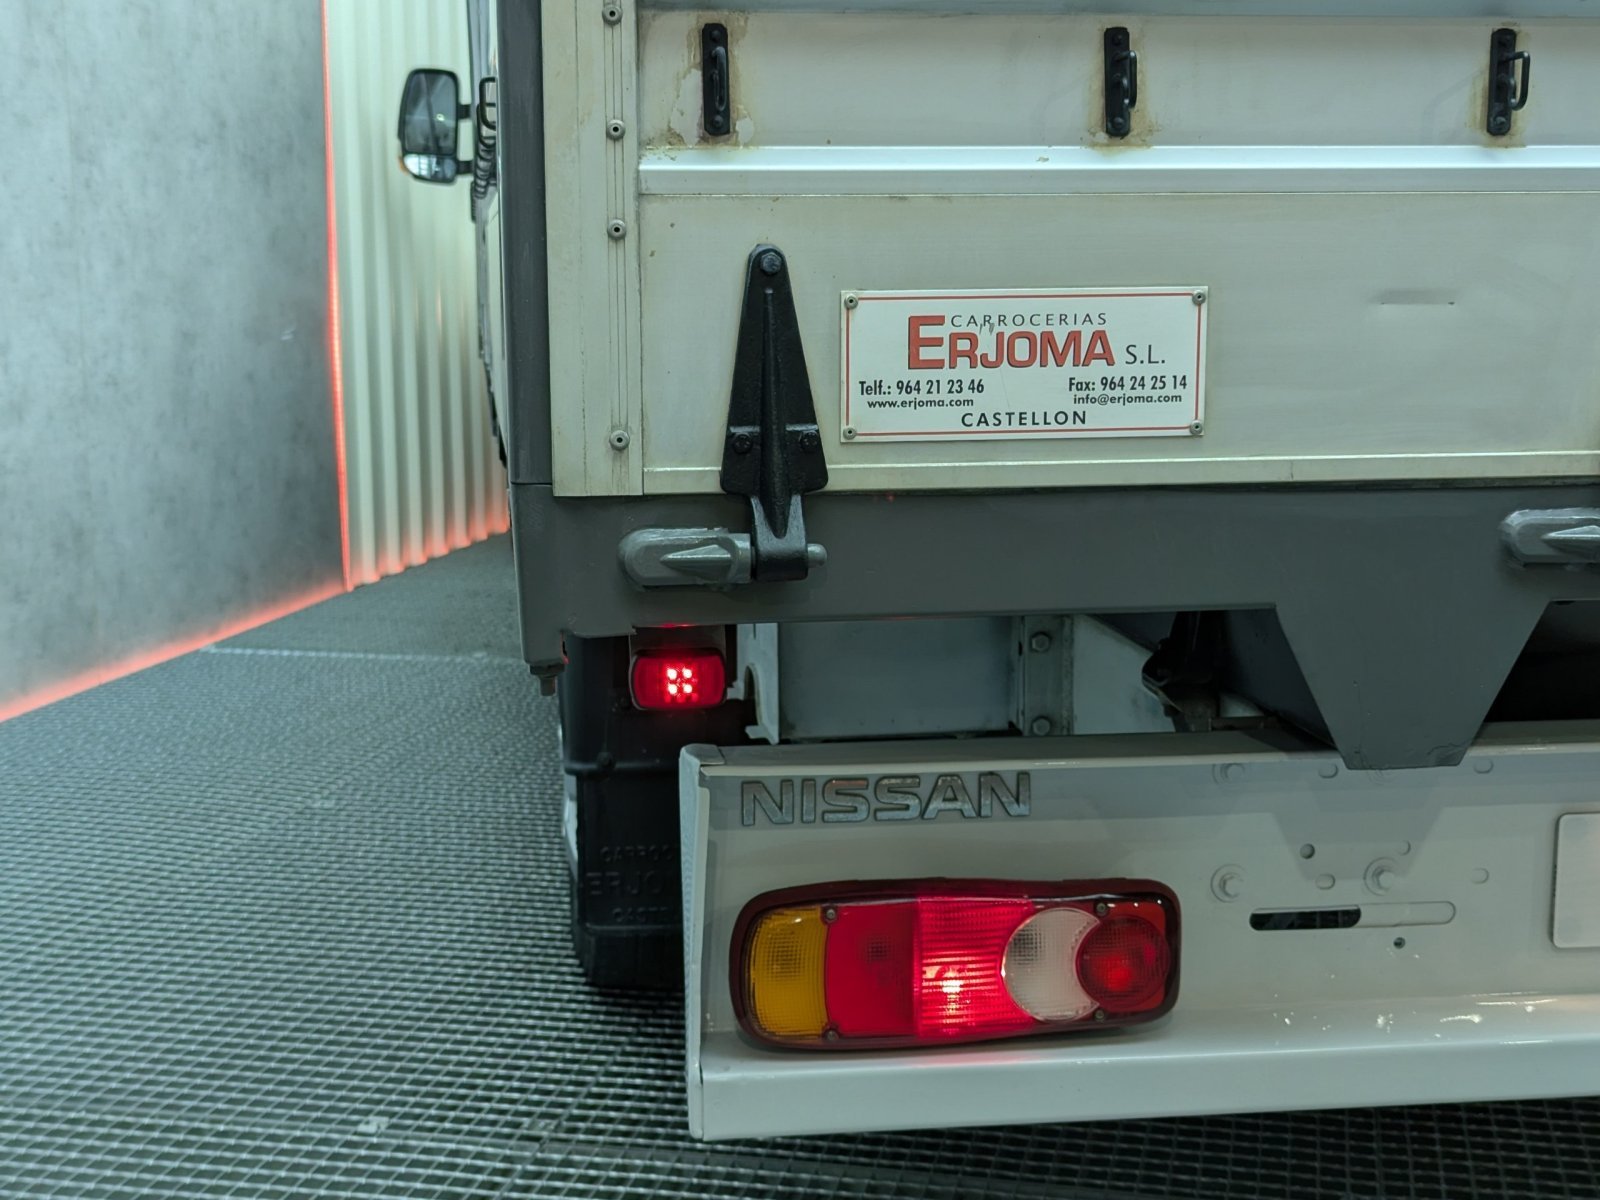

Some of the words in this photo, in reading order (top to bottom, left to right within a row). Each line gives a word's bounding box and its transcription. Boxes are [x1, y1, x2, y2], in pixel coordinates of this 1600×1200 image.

[950, 312, 1108, 327] CARROCERIAS
[1125, 344, 1166, 365] S.L.
[859, 380, 892, 396] Telf.:
[896, 379, 921, 395] 964
[926, 379, 943, 395] 21
[947, 379, 964, 394] 23
[967, 378, 985, 394] 46
[1068, 377, 1096, 392] Fax:
[1100, 376, 1125, 391] 964
[1129, 376, 1146, 391] 24
[1149, 375, 1167, 390] 25
[1172, 375, 1187, 390] 14
[867, 396, 974, 409] www.erjoma.com
[1073, 393, 1183, 406] info@erjoma.com
[961, 410, 1087, 427] CASTELLON
[741, 772, 1030, 826] NISSAN
